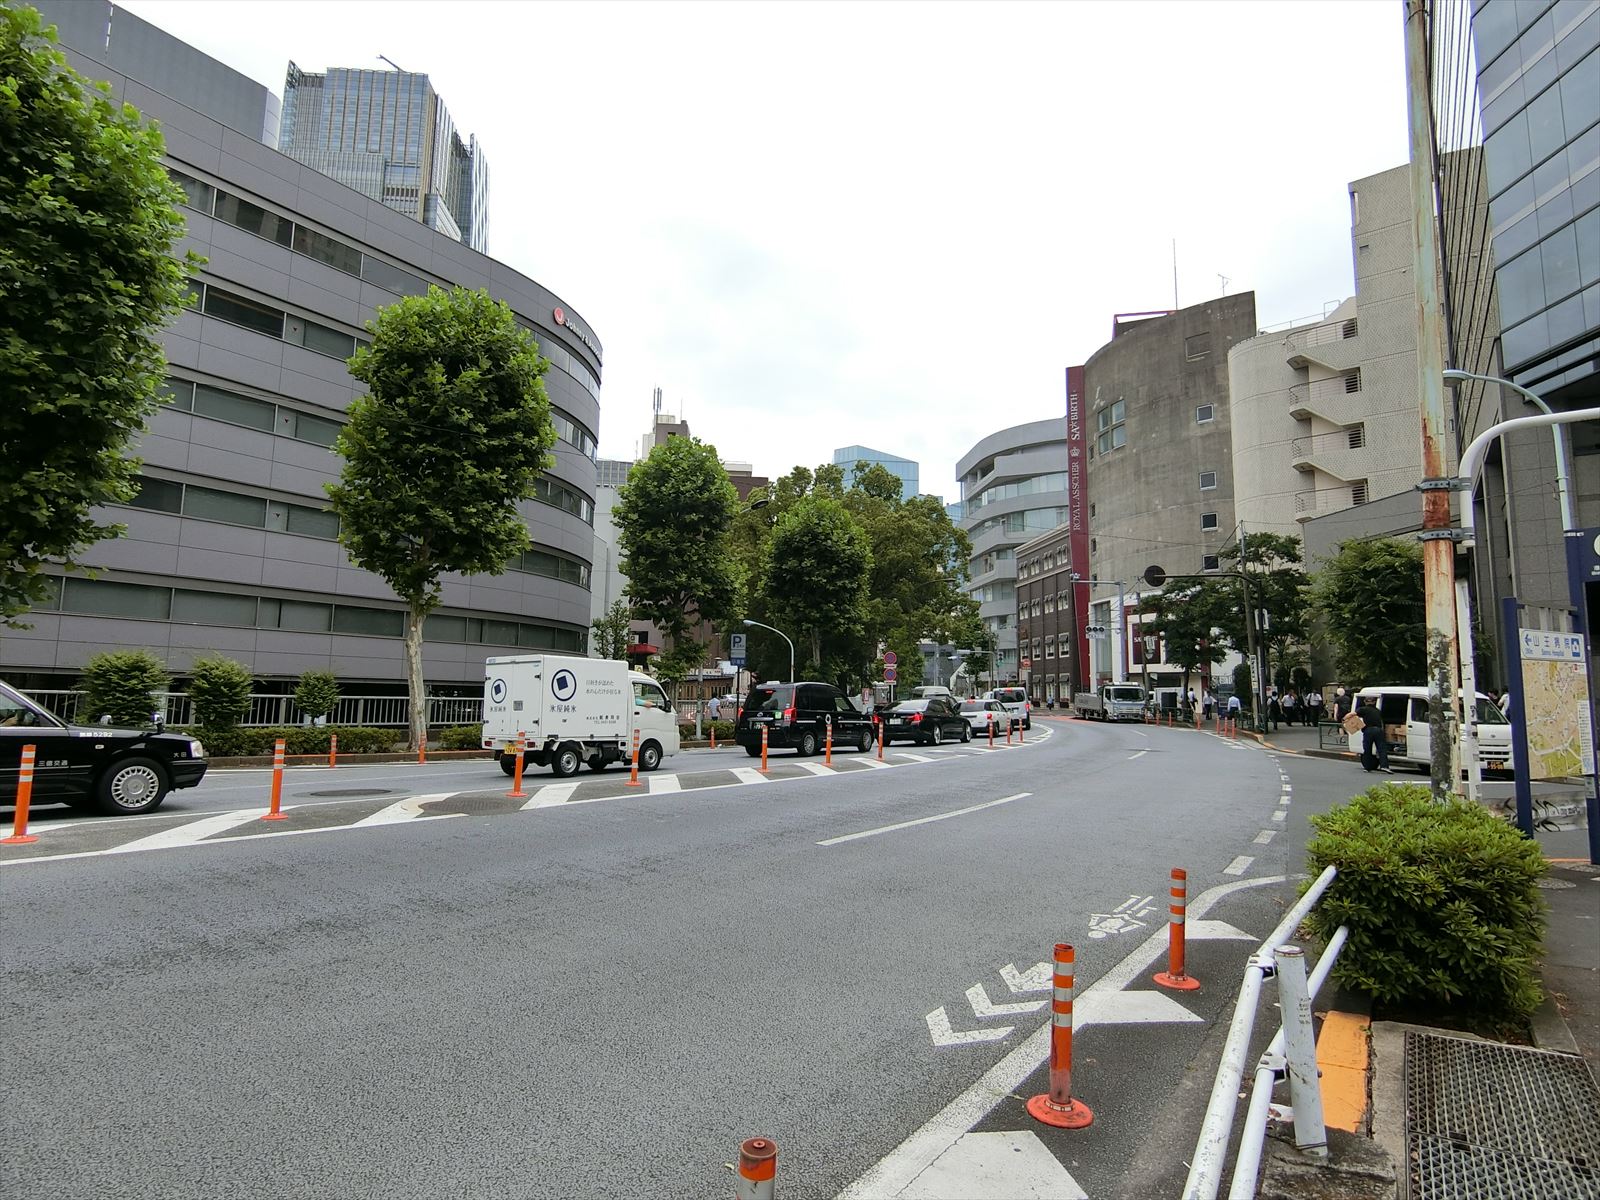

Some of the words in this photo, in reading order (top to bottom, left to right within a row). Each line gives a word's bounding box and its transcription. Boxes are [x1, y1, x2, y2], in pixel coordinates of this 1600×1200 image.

[1071, 461, 1080, 500] ASSCHER
[1073, 502, 1081, 531] ROYAL
[732, 635, 742, 648] P
